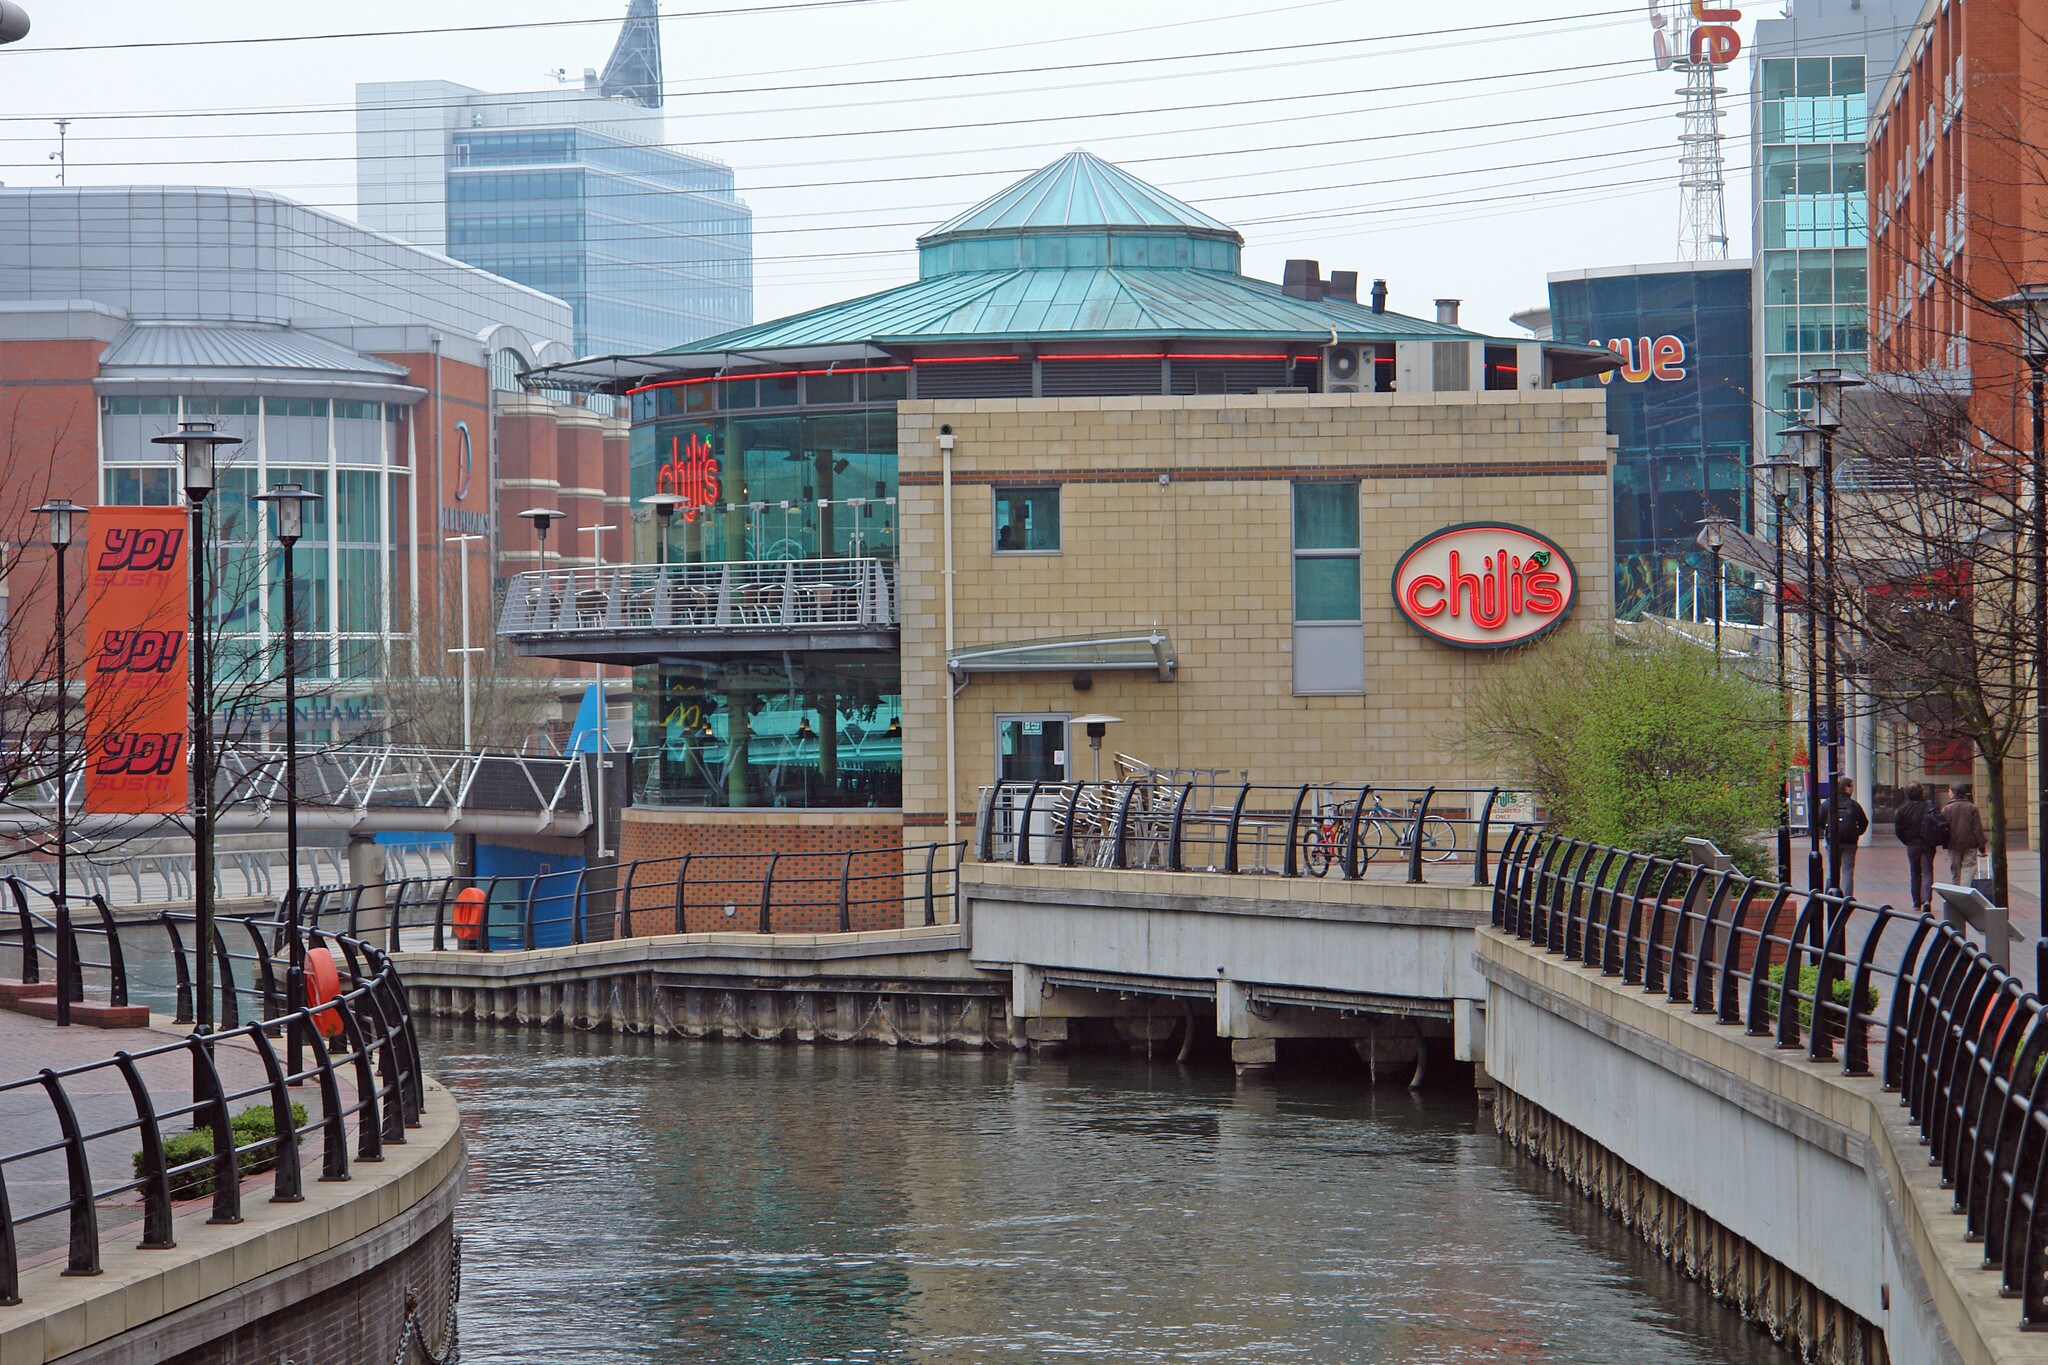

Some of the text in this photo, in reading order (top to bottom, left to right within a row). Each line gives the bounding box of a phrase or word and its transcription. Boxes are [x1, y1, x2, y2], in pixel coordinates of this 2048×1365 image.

[97, 529, 184, 571] YO!
[93, 571, 171, 587] sushi
[96, 630, 183, 673] YO!
[223, 705, 374, 723] DEBENHAMS
[96, 732, 183, 775] YO!
[93, 775, 171, 791] sushi
